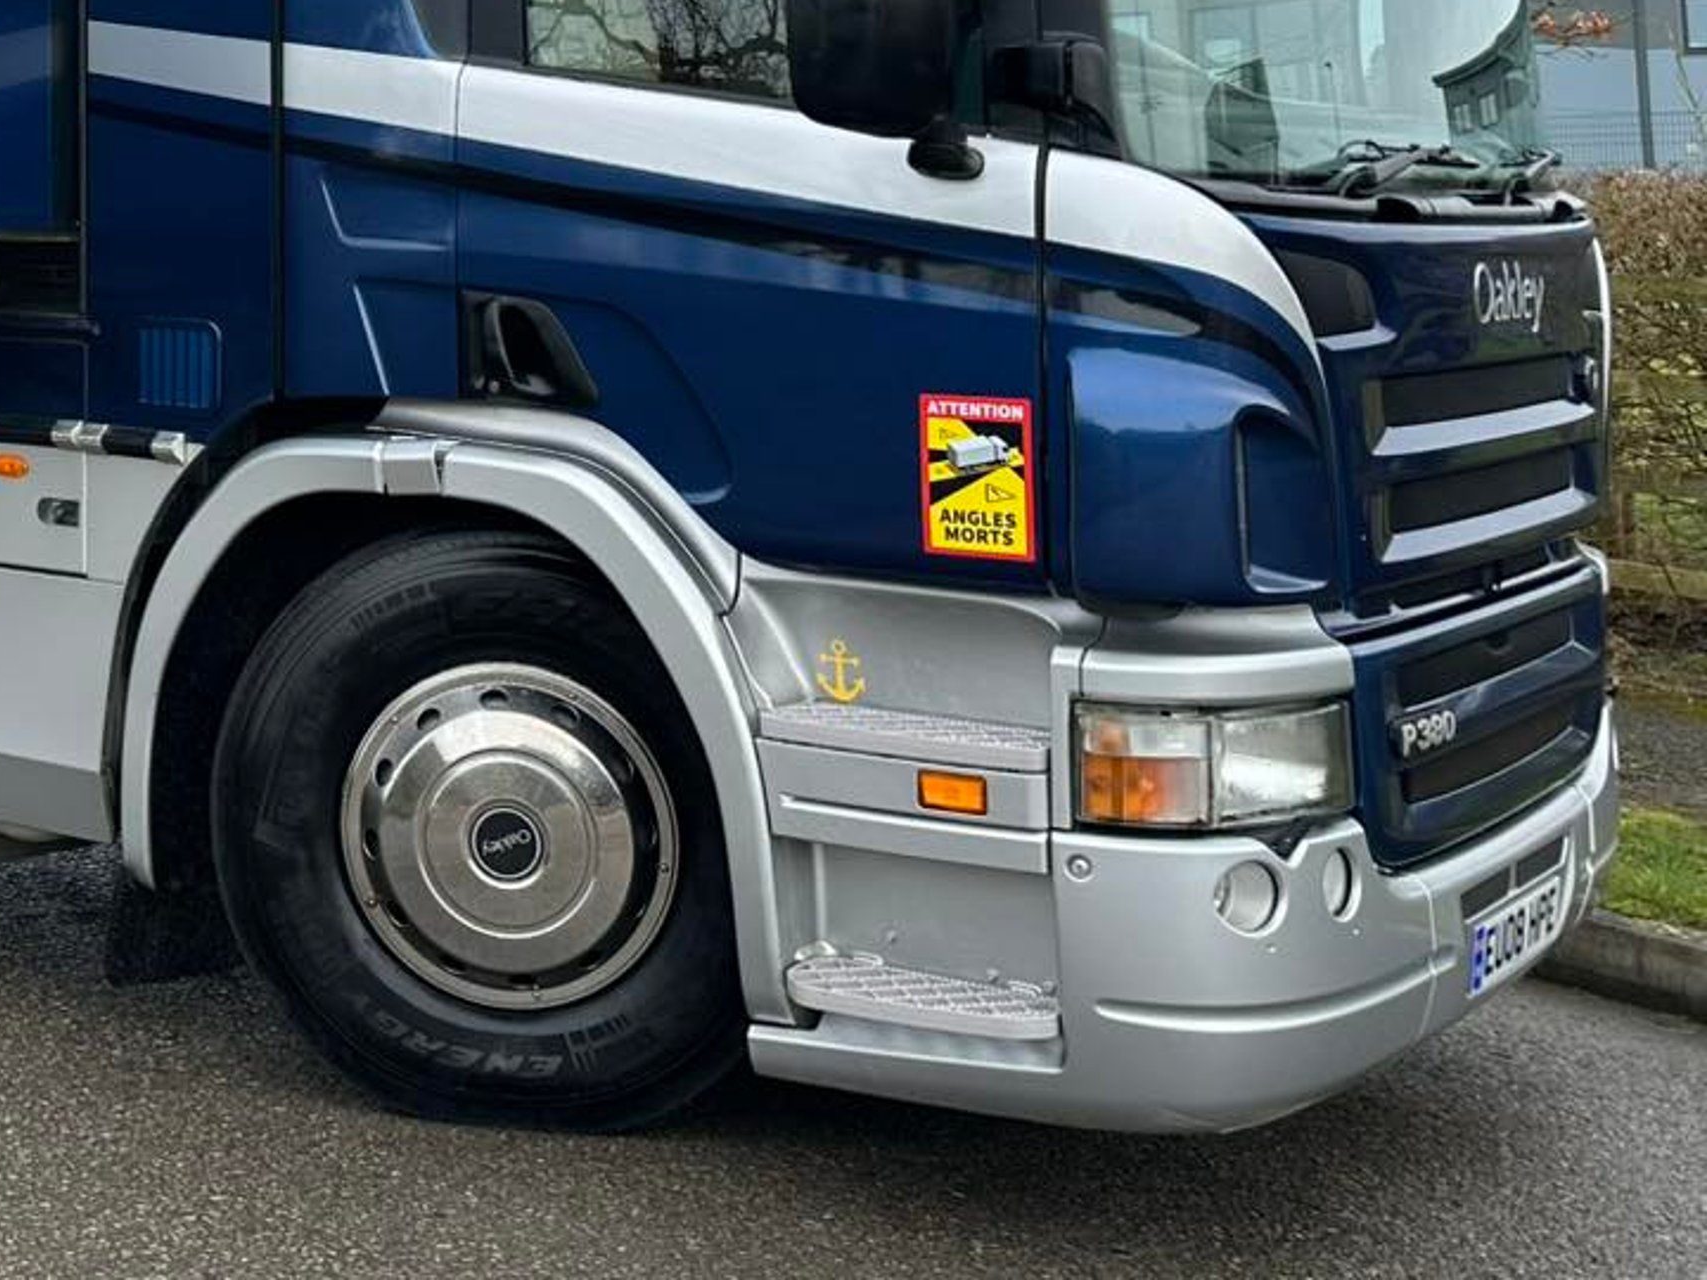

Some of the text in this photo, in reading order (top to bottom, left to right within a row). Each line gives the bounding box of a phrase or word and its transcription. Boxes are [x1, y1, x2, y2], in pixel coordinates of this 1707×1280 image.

[1473, 260, 1545, 334] Oakley
[927, 400, 1024, 419] ATTENTION
[939, 508, 1017, 530] ANGLES
[944, 527, 1014, 547] MORTS
[1400, 709, 1456, 758] P380
